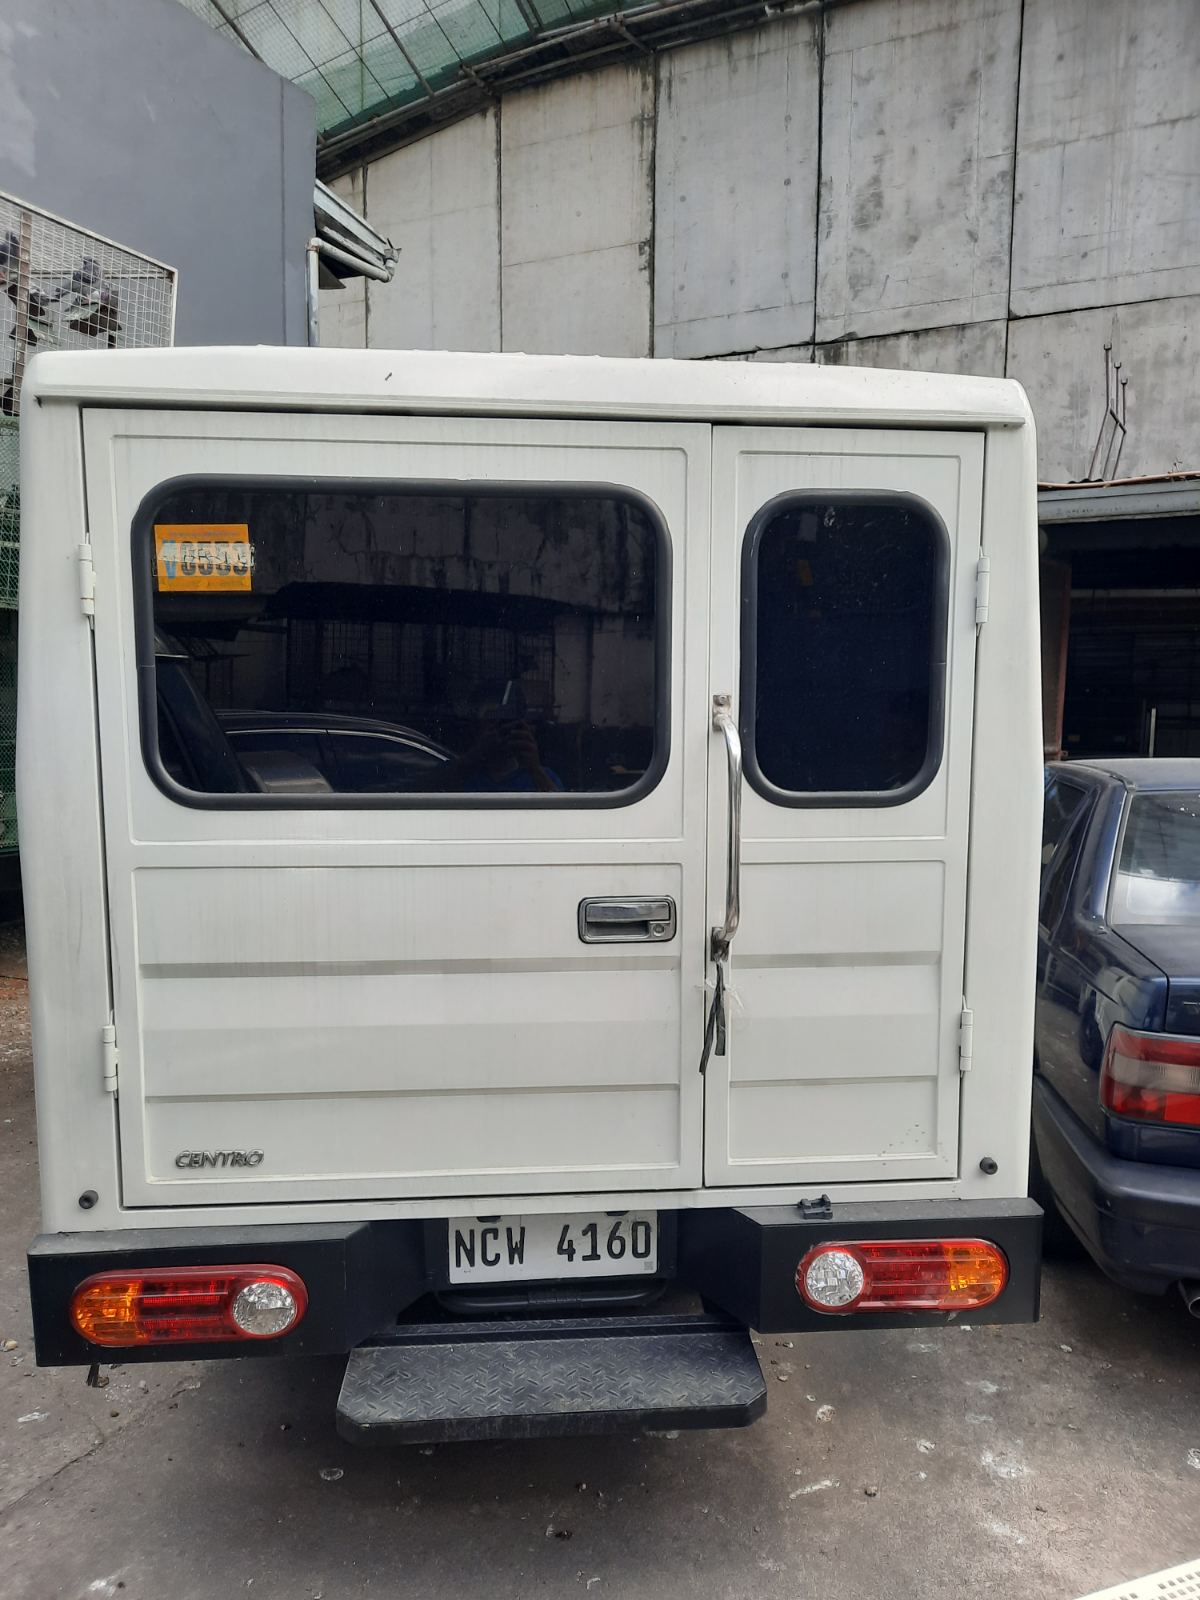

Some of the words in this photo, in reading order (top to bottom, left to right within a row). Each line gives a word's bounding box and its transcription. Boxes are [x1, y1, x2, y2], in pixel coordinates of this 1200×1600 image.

[175, 1149, 264, 1168] CENTRO
[455, 1226, 525, 1268] NCW
[557, 1221, 651, 1262] 4160
